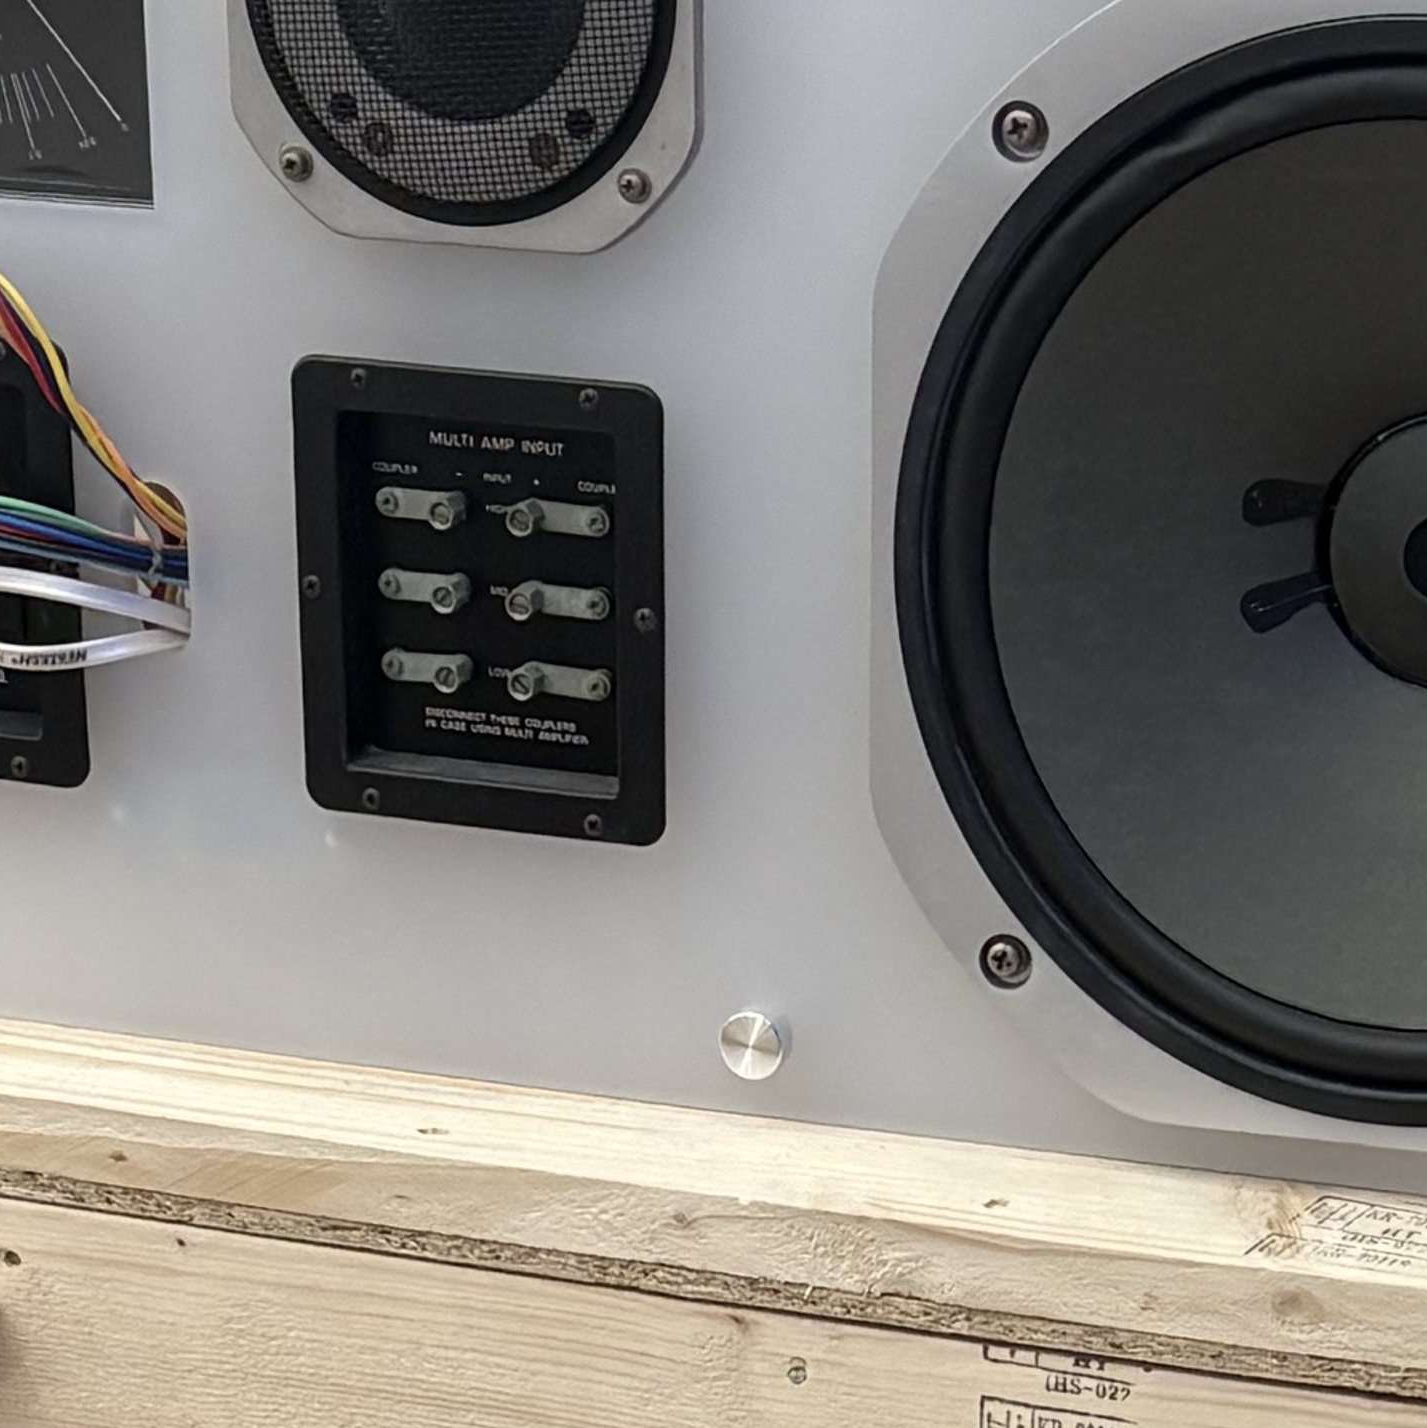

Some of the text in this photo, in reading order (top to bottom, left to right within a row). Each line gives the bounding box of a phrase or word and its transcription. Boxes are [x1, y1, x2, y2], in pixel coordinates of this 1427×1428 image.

[429, 431, 564, 456] MULTI AMP INPUT
